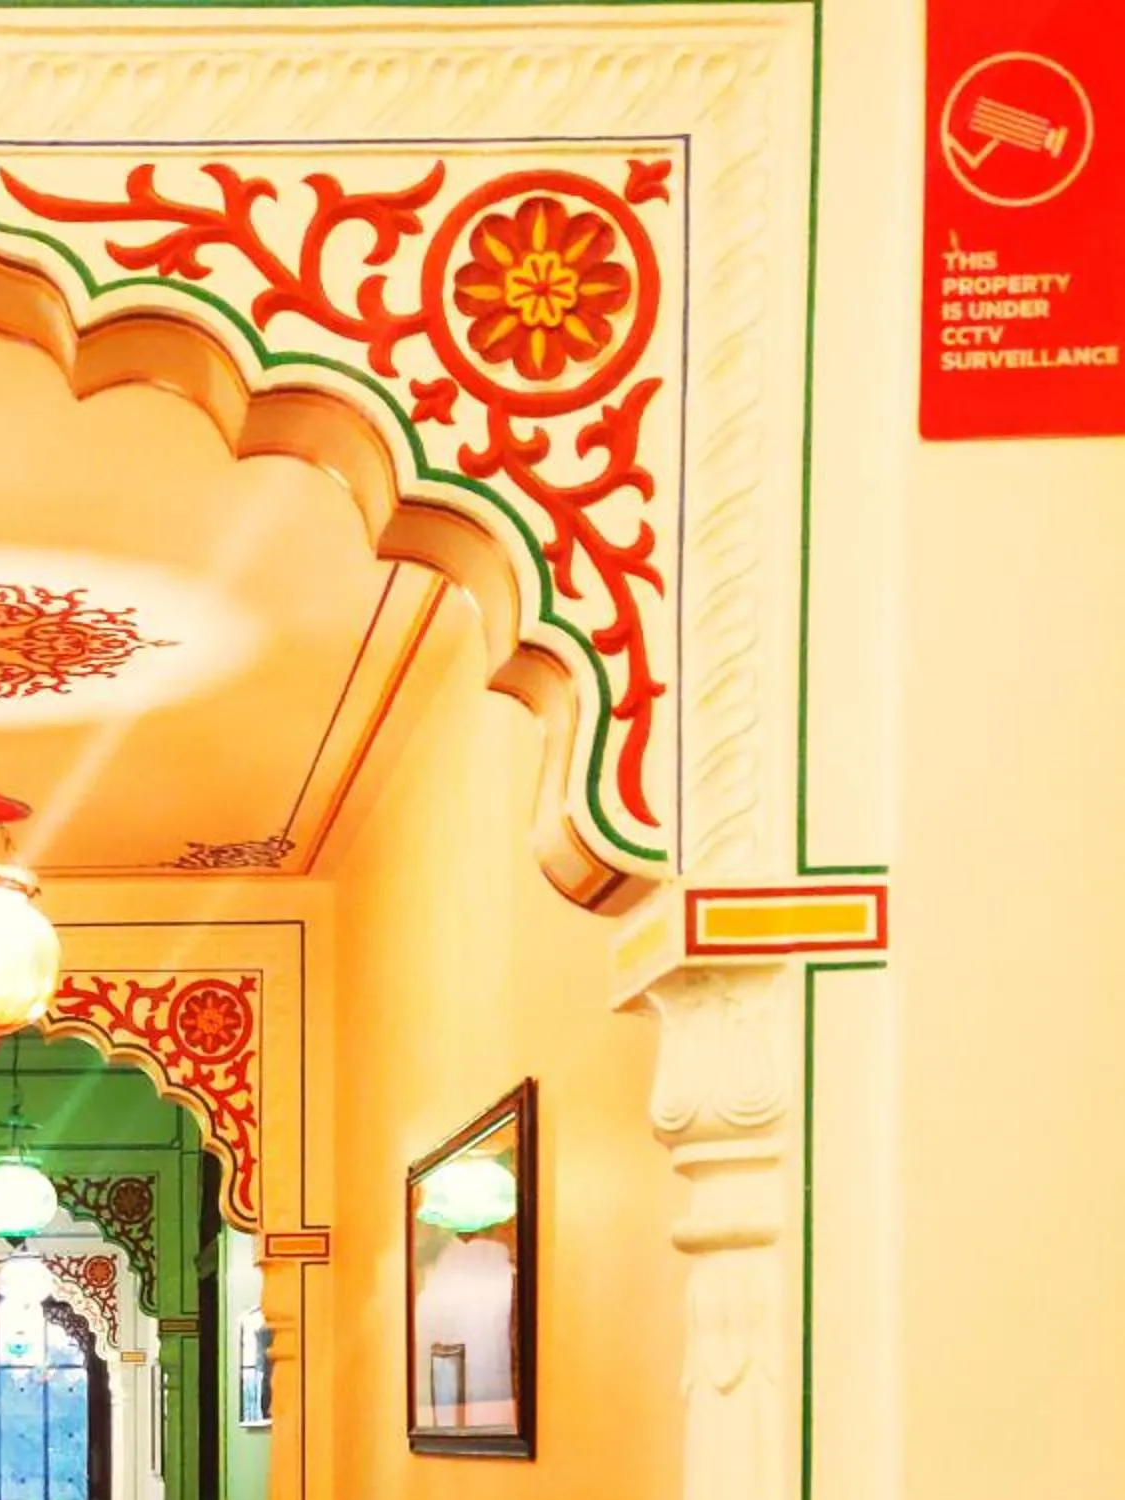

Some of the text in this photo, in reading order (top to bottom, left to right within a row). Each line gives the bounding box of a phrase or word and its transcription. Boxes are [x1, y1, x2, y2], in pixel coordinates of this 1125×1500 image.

[942, 251, 997, 270] THIS
[941, 273, 1070, 296] PROPERTY
[941, 299, 1049, 320] IS UNDER
[941, 326, 1004, 345] CCTV
[940, 346, 1119, 371] SURVEILLANCE
